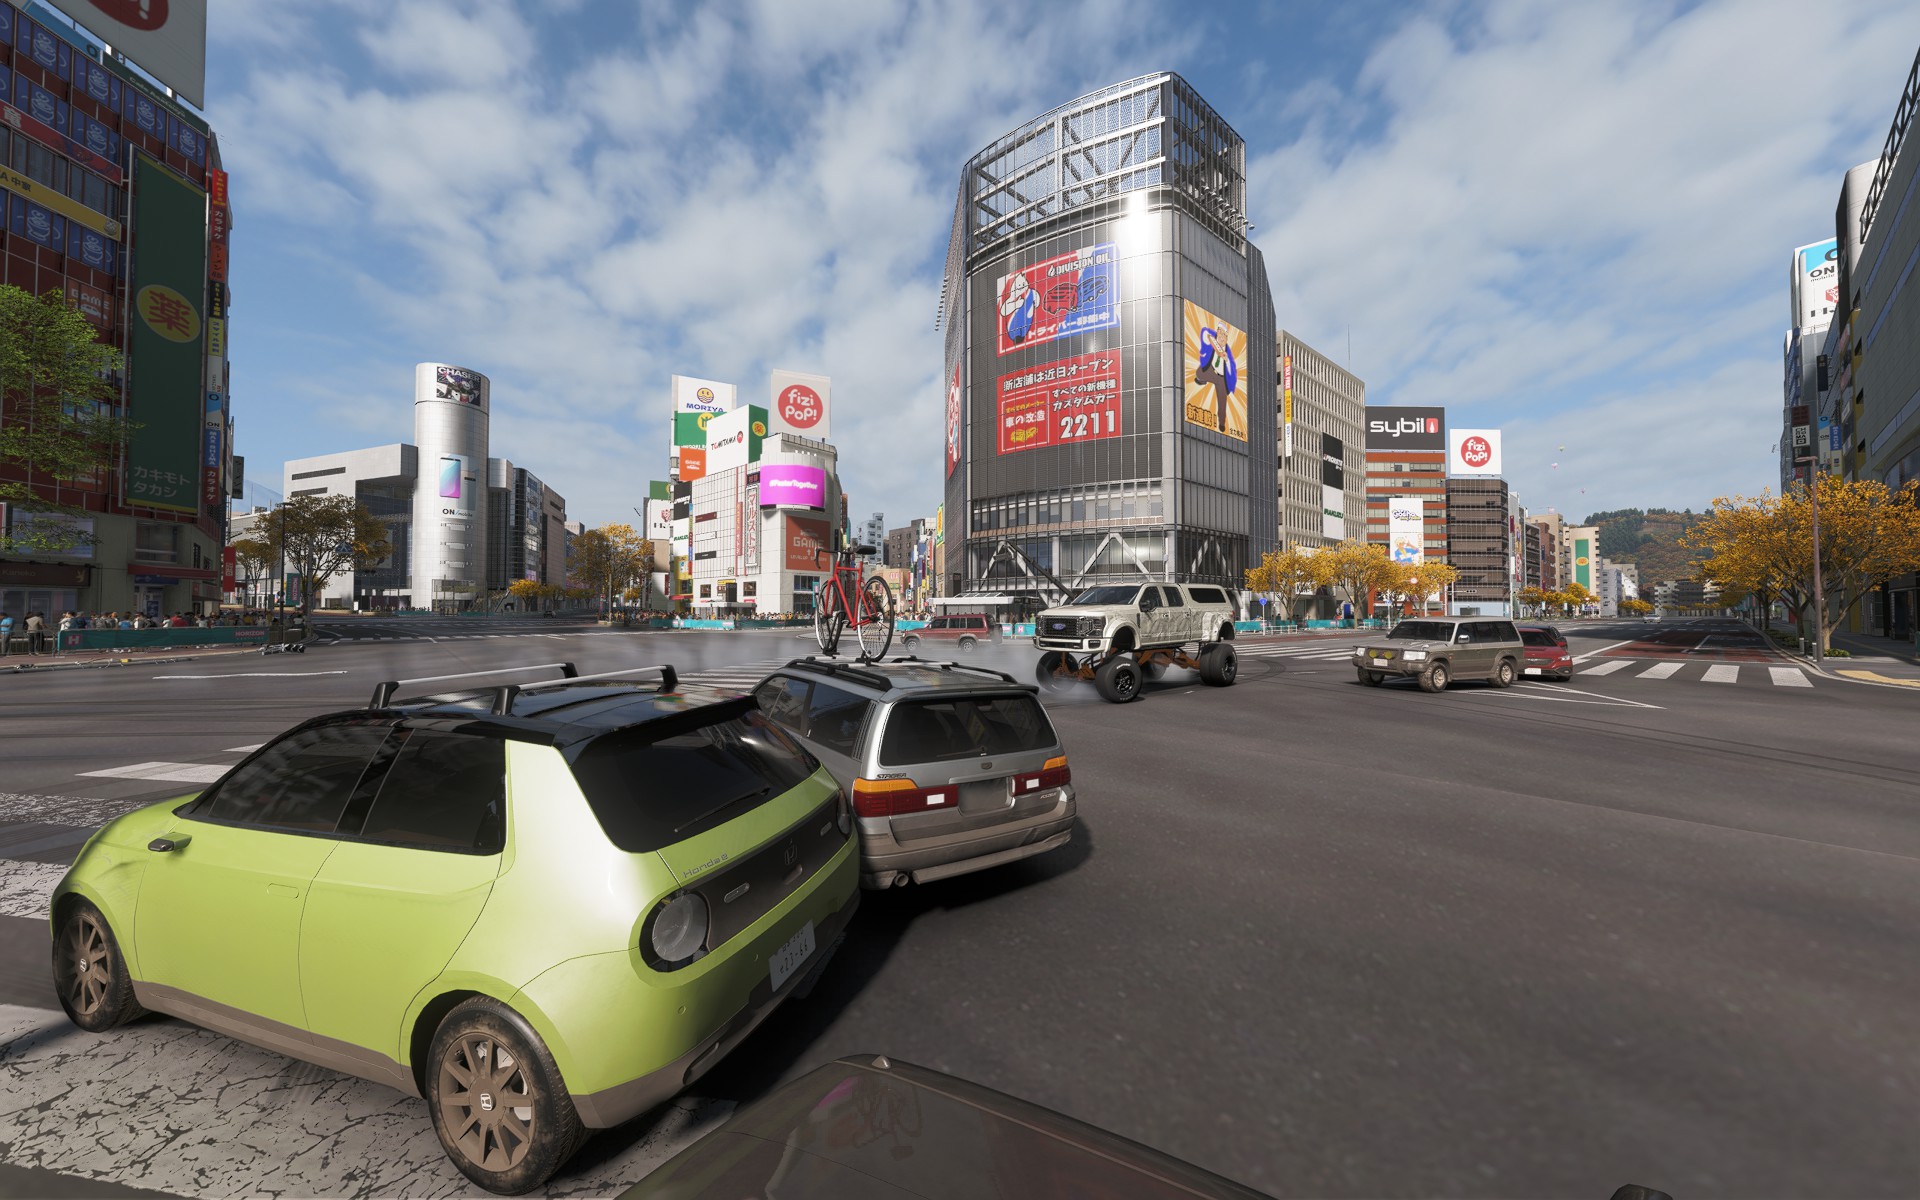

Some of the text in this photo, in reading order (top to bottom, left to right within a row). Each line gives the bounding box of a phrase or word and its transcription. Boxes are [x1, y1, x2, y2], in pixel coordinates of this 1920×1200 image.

[1057, 256, 1094, 275] DIVISION
[1810, 265, 1835, 278] ON
[148, 290, 190, 338] 薬
[437, 367, 480, 382] CHASER
[788, 388, 814, 406] fizi
[685, 402, 724, 412] MORIYA
[1060, 410, 1115, 439] 2211
[1370, 417, 1424, 437] sybil
[1467, 439, 1485, 451] fizi
[133, 465, 191, 486] カキモト
[133, 480, 177, 498] タカシ
[793, 536, 824, 549] GAME
[683, 857, 721, 879] Honda
